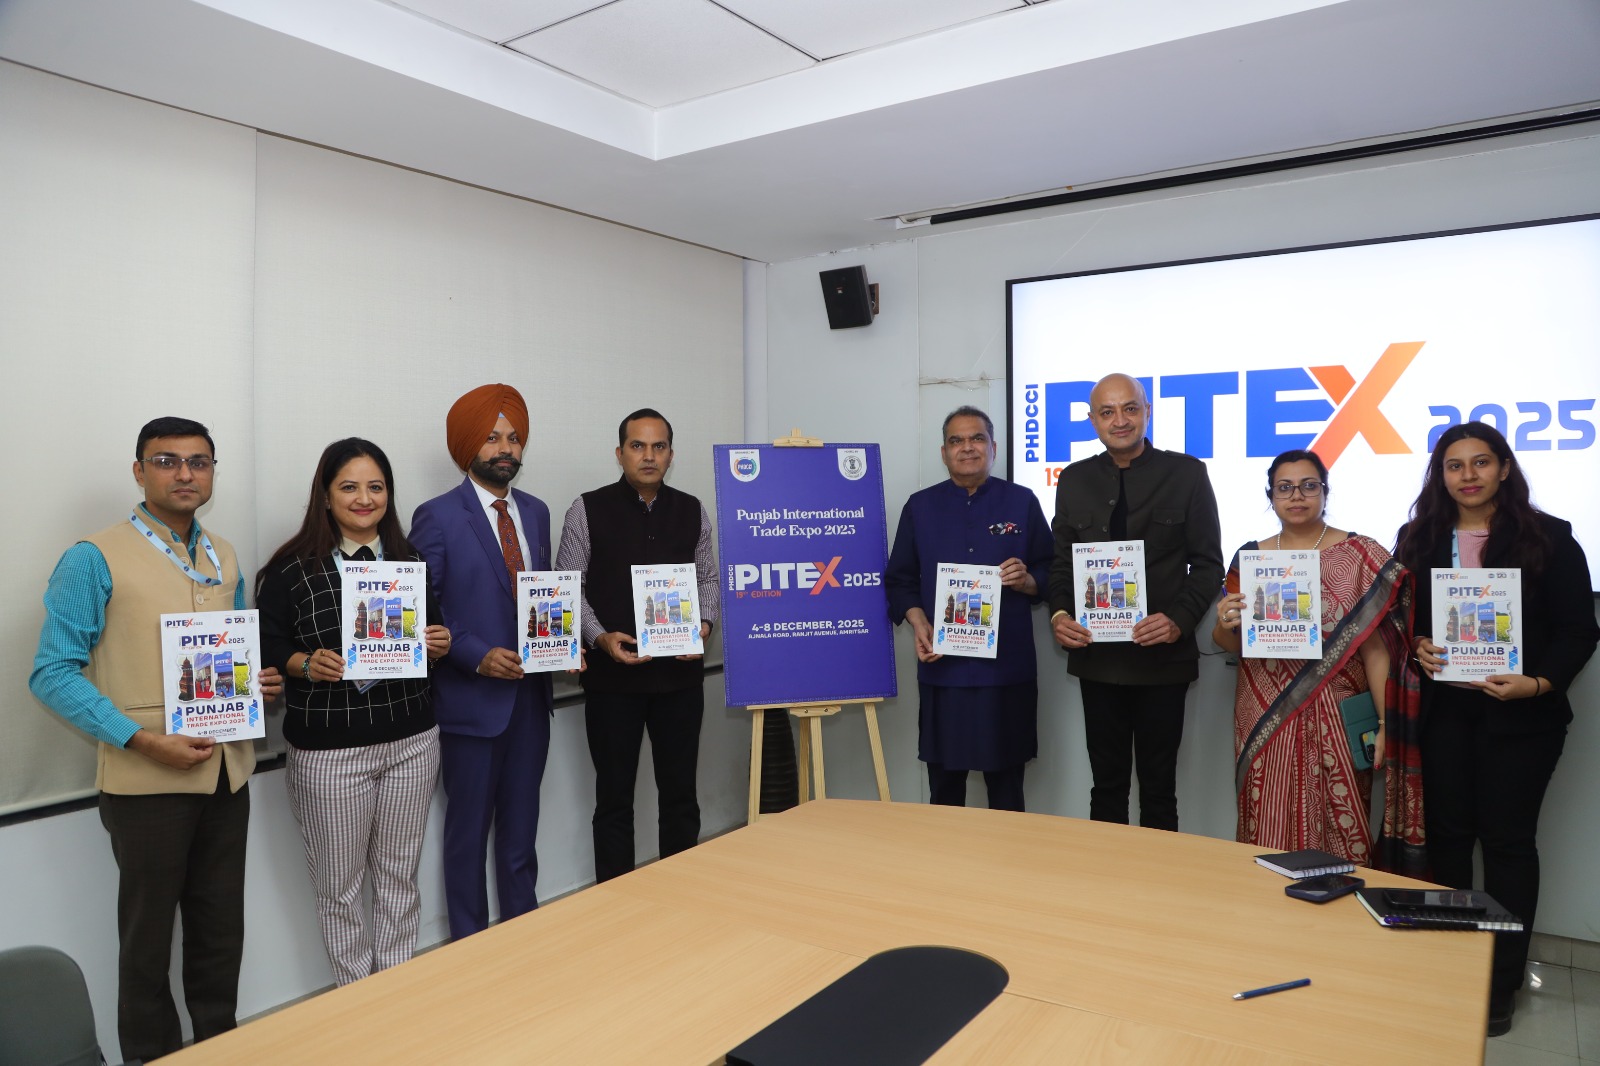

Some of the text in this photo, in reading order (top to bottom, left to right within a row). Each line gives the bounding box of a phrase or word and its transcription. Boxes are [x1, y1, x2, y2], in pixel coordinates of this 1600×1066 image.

[1045, 341, 1427, 474] PTEX
[1026, 384, 1039, 462] PHDCCI
[737, 506, 864, 524] Punjab International
[750, 524, 856, 538] Trade Expo 2025
[1087, 557, 1121, 569] PITEX
[346, 566, 369, 574] PITEX
[735, 556, 882, 596] PITEX 2025
[1256, 566, 1294, 578] PITEX
[358, 580, 399, 593] PITEX
[646, 578, 675, 588] PITEX
[950, 579, 980, 590] PITEX
[530, 586, 560, 598] PITEX
[1449, 585, 1491, 598] PITEX
[167, 618, 193, 627] PITEX
[752, 619, 864, 632] 4-8 DECEMBER, 2025
[650, 627, 689, 635] PUNJAB
[947, 628, 985, 636] PUNJAB
[182, 631, 229, 647] PITEX
[532, 640, 568, 649] PUNJAB
[360, 644, 410, 652] PUNJAB
[186, 702, 244, 716] PUNJAB
[187, 712, 245, 722] INTERNATIONAL
